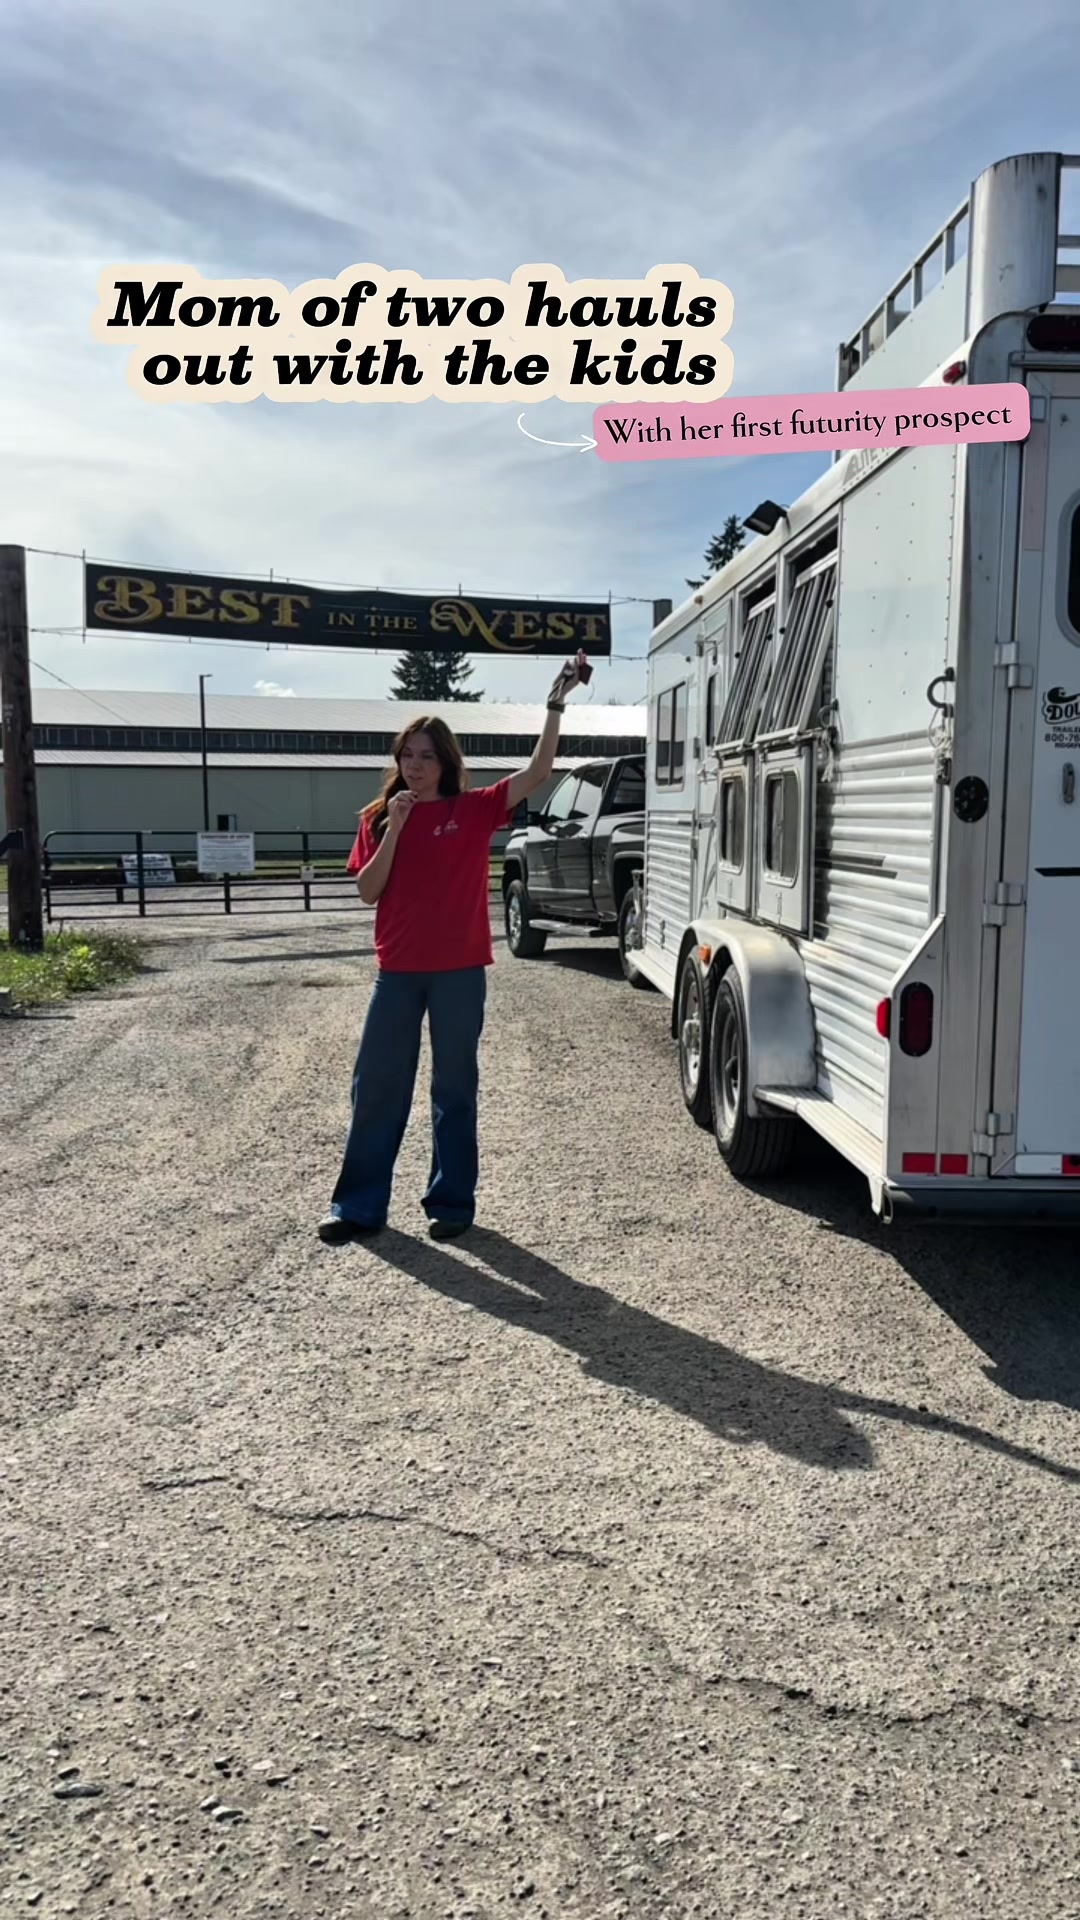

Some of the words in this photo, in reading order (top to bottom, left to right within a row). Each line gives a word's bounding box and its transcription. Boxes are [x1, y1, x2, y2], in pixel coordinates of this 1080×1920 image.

[94, 575, 311, 628] BEST
[327, 611, 355, 627] IN
[364, 614, 418, 630] THE
[430, 599, 607, 651] WEST
[1044, 733, 1080, 742] 800-76
